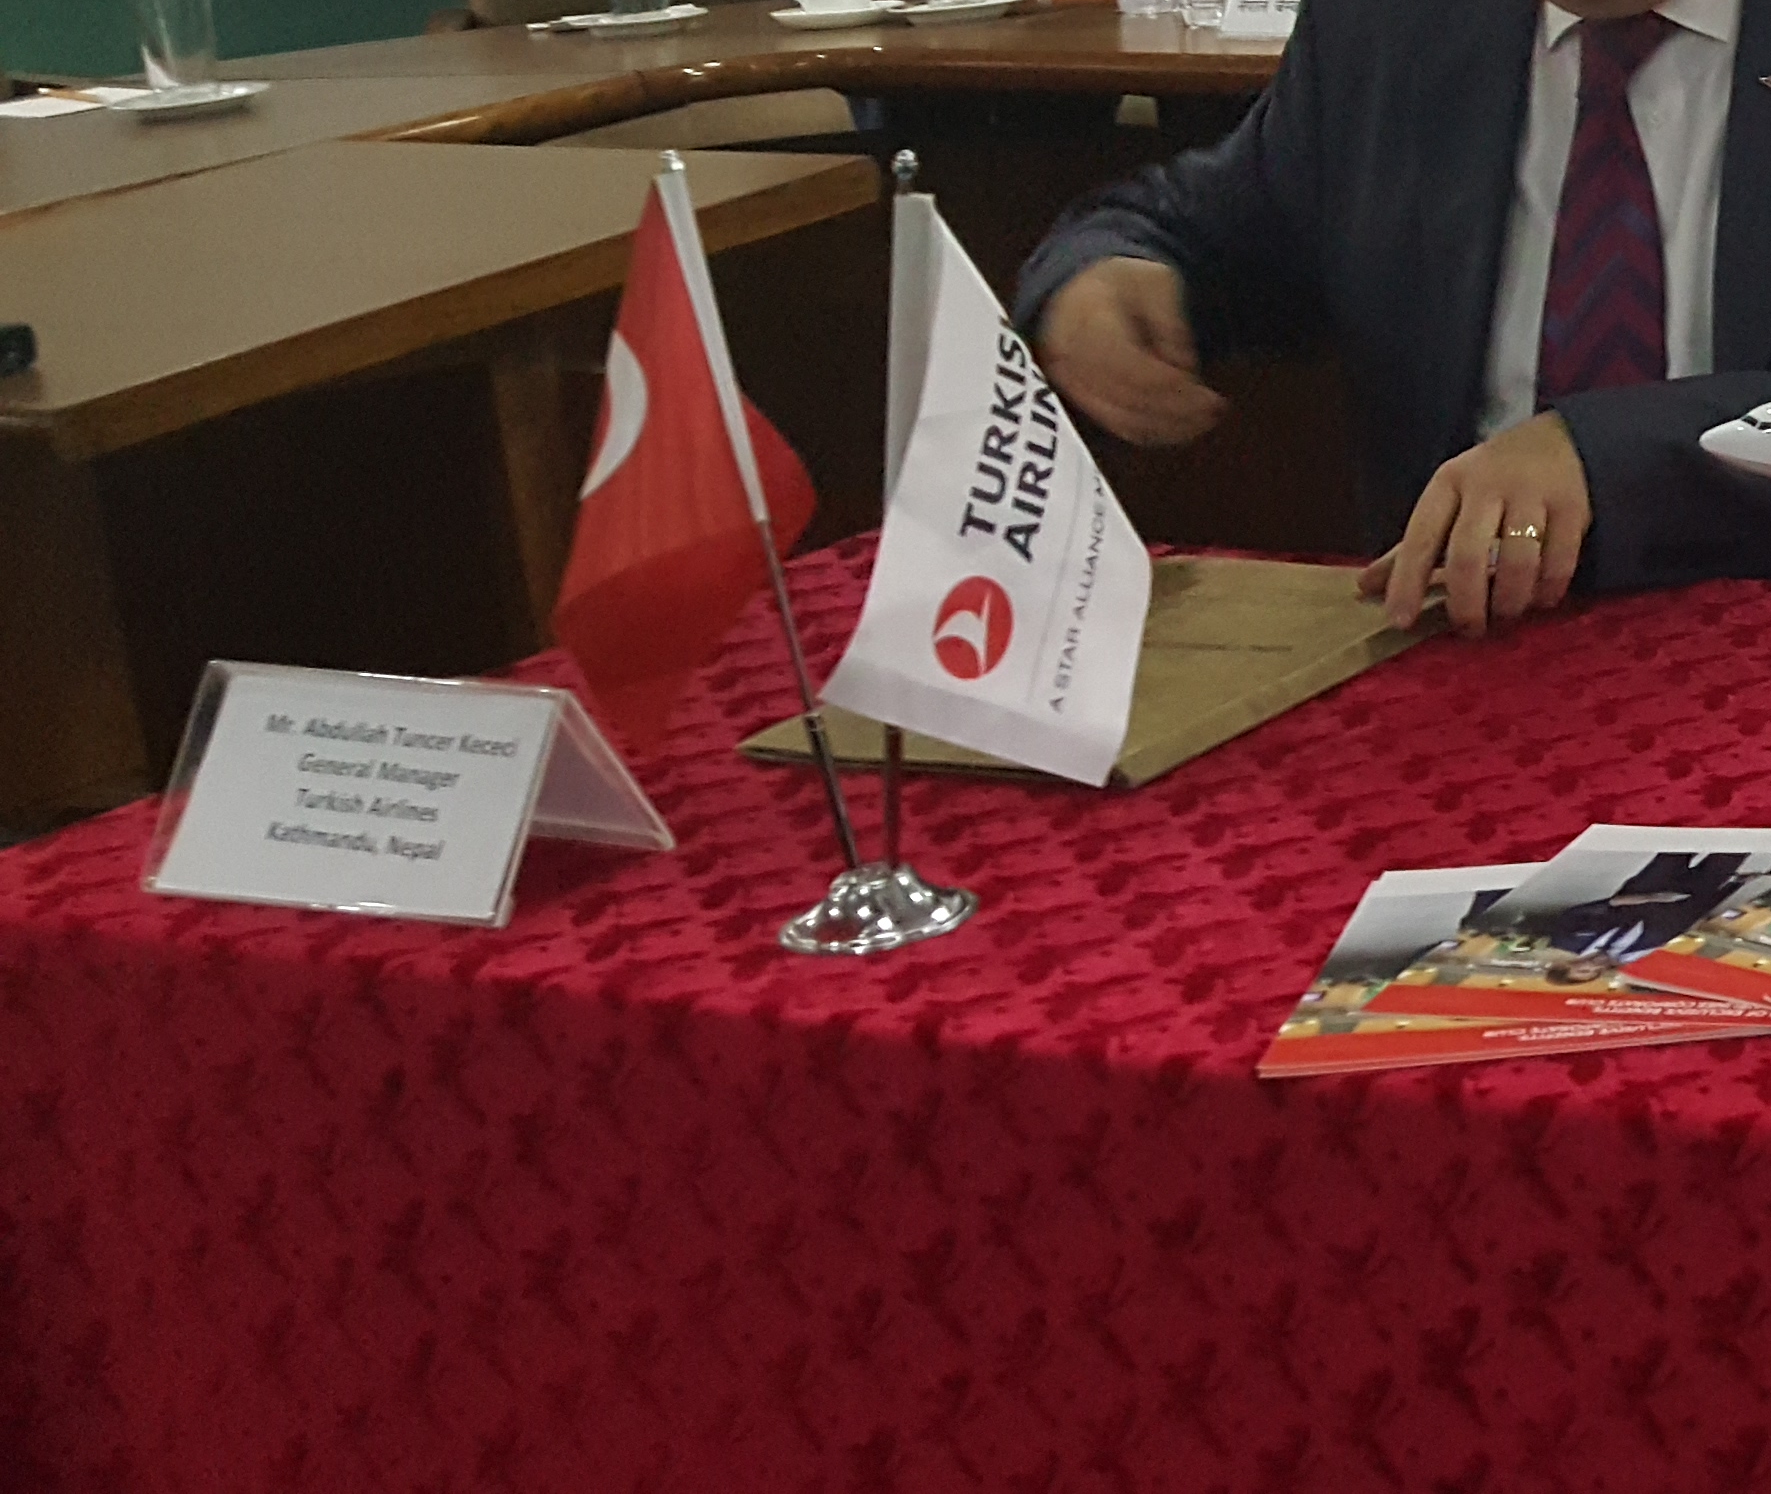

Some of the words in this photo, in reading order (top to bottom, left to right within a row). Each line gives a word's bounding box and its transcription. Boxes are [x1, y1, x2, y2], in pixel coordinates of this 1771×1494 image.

[959, 316, 1032, 540] TURKIS
[1052, 623, 1082, 689] STAR
[265, 714, 297, 734] Mr.
[297, 753, 377, 779] General
[376, 761, 461, 791] Manager
[296, 787, 365, 813] Turkish
[366, 796, 439, 823] Airlines
[384, 834, 447, 861] Nepal
